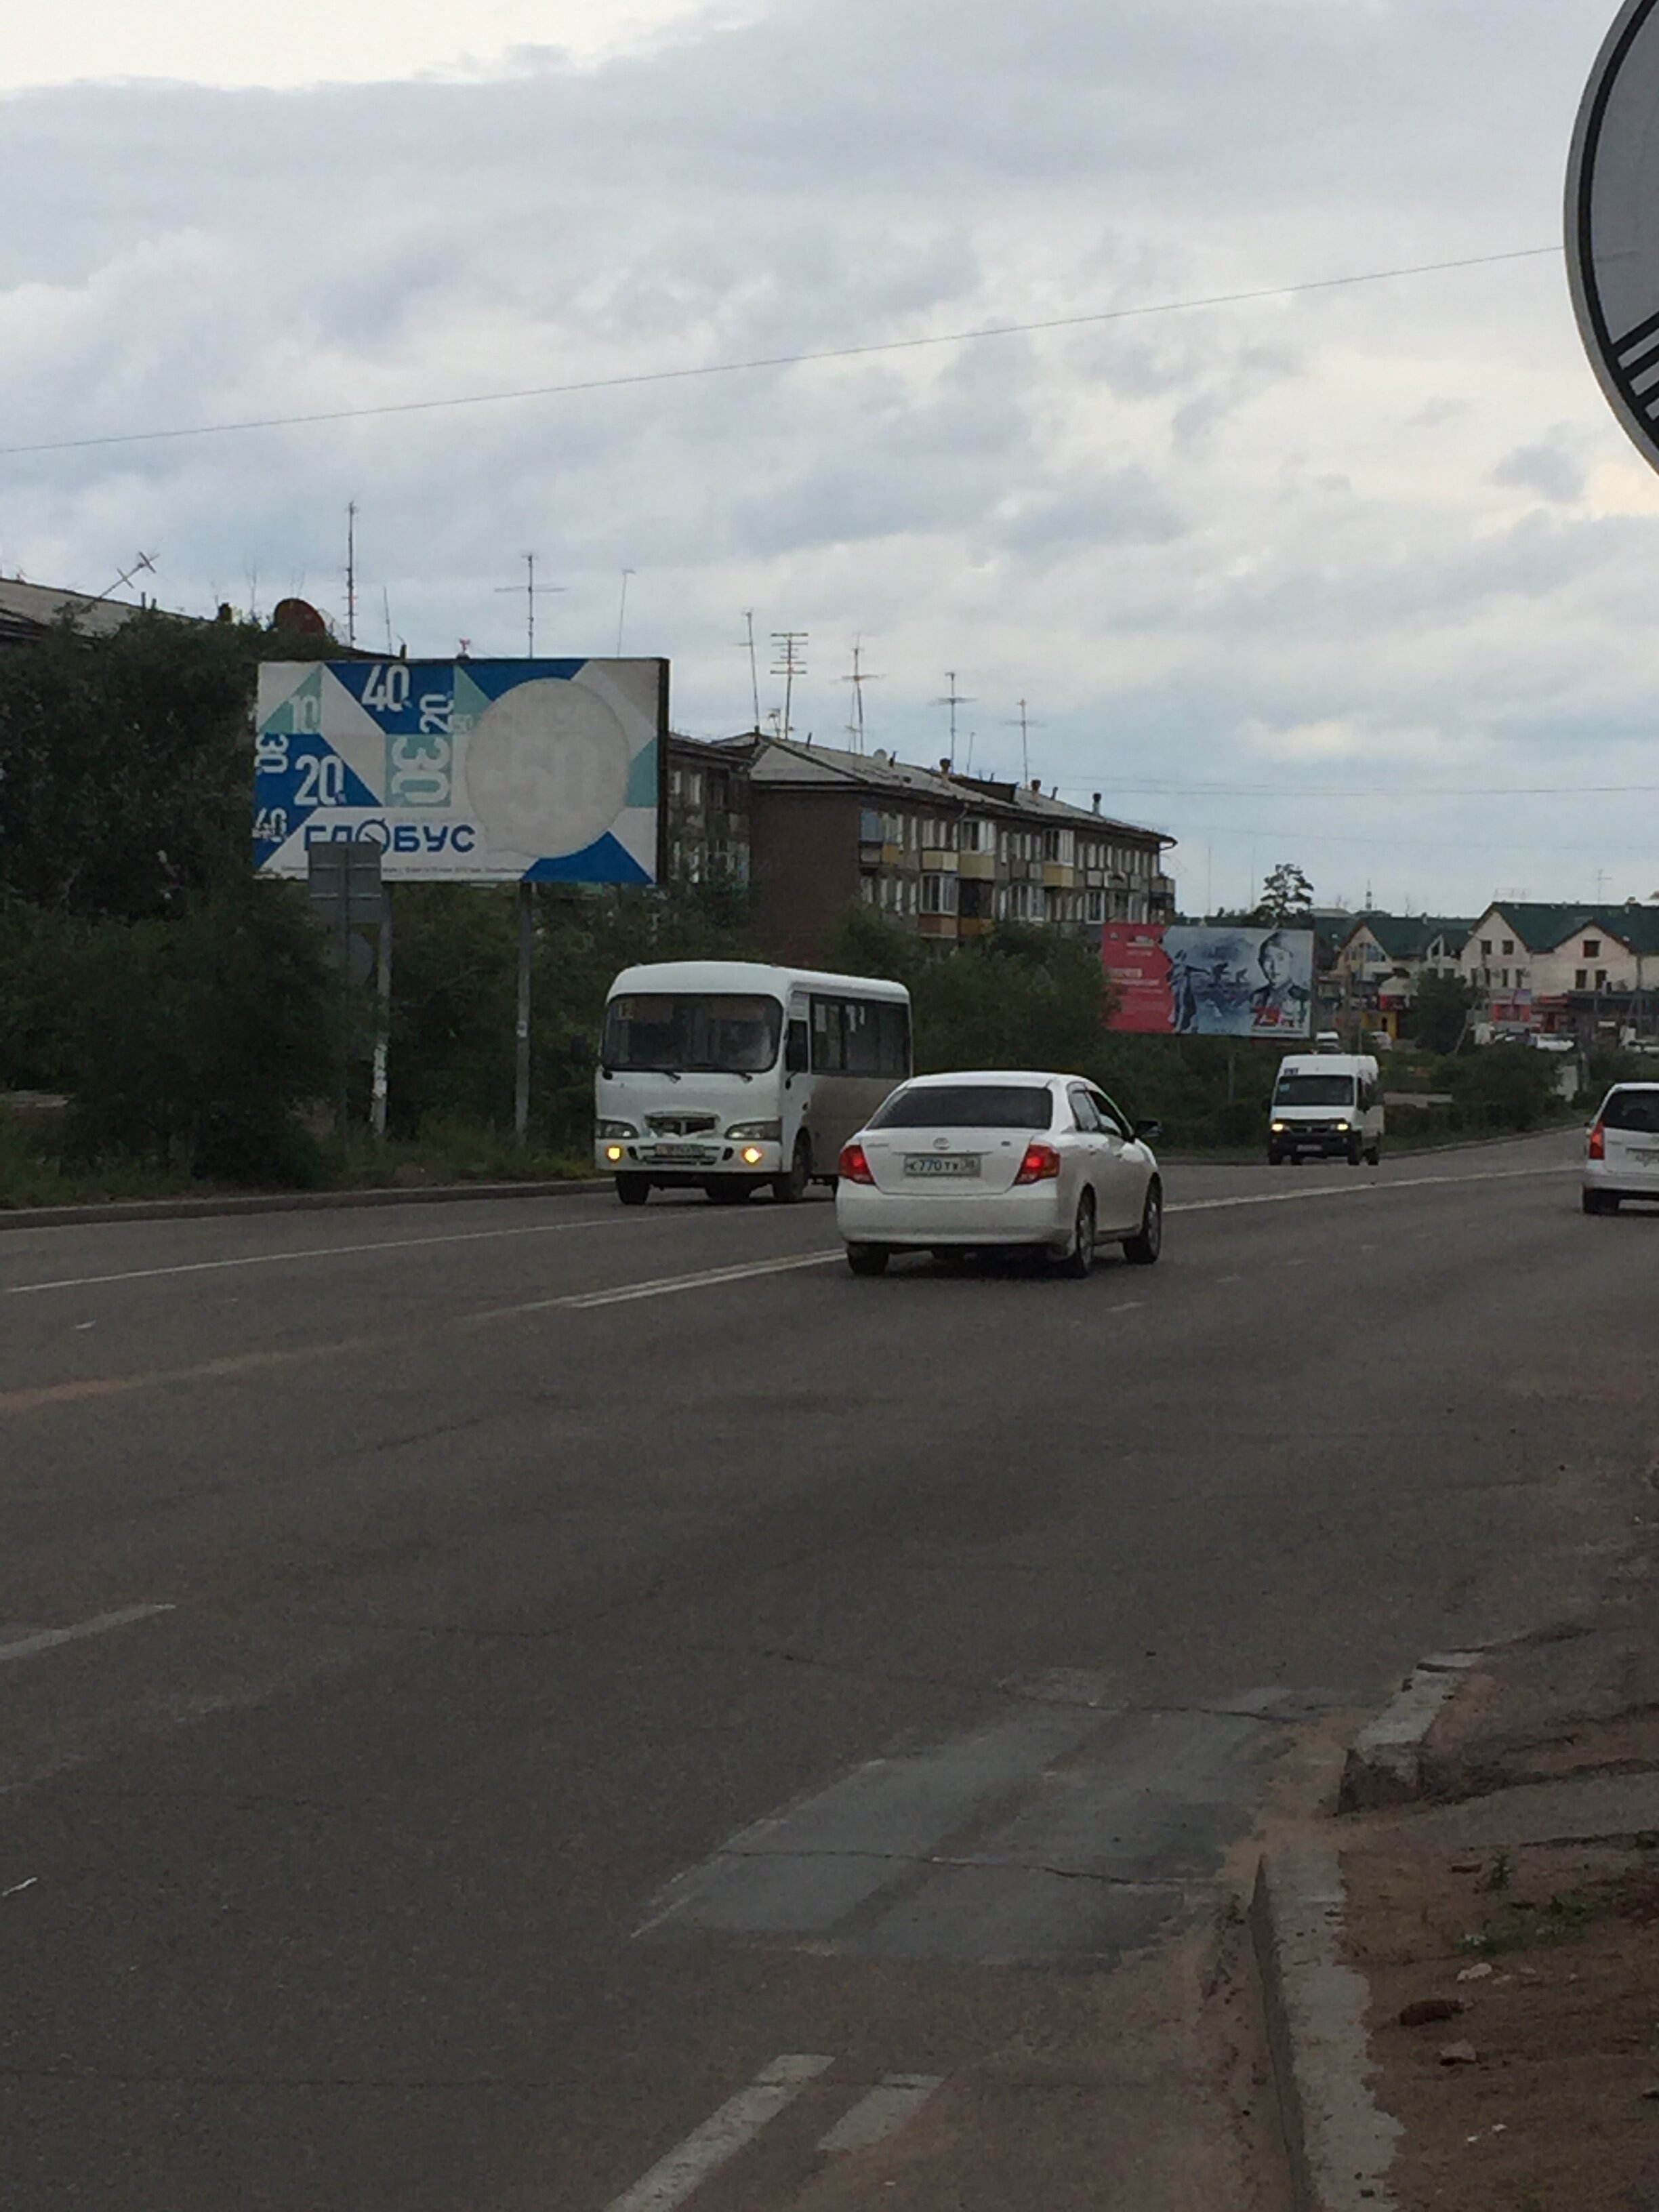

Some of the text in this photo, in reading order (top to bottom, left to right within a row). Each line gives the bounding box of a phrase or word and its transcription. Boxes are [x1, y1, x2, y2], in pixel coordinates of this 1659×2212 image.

[362, 664, 409, 710] 40
[294, 754, 344, 806] 20
[391, 737, 450, 803] 30
